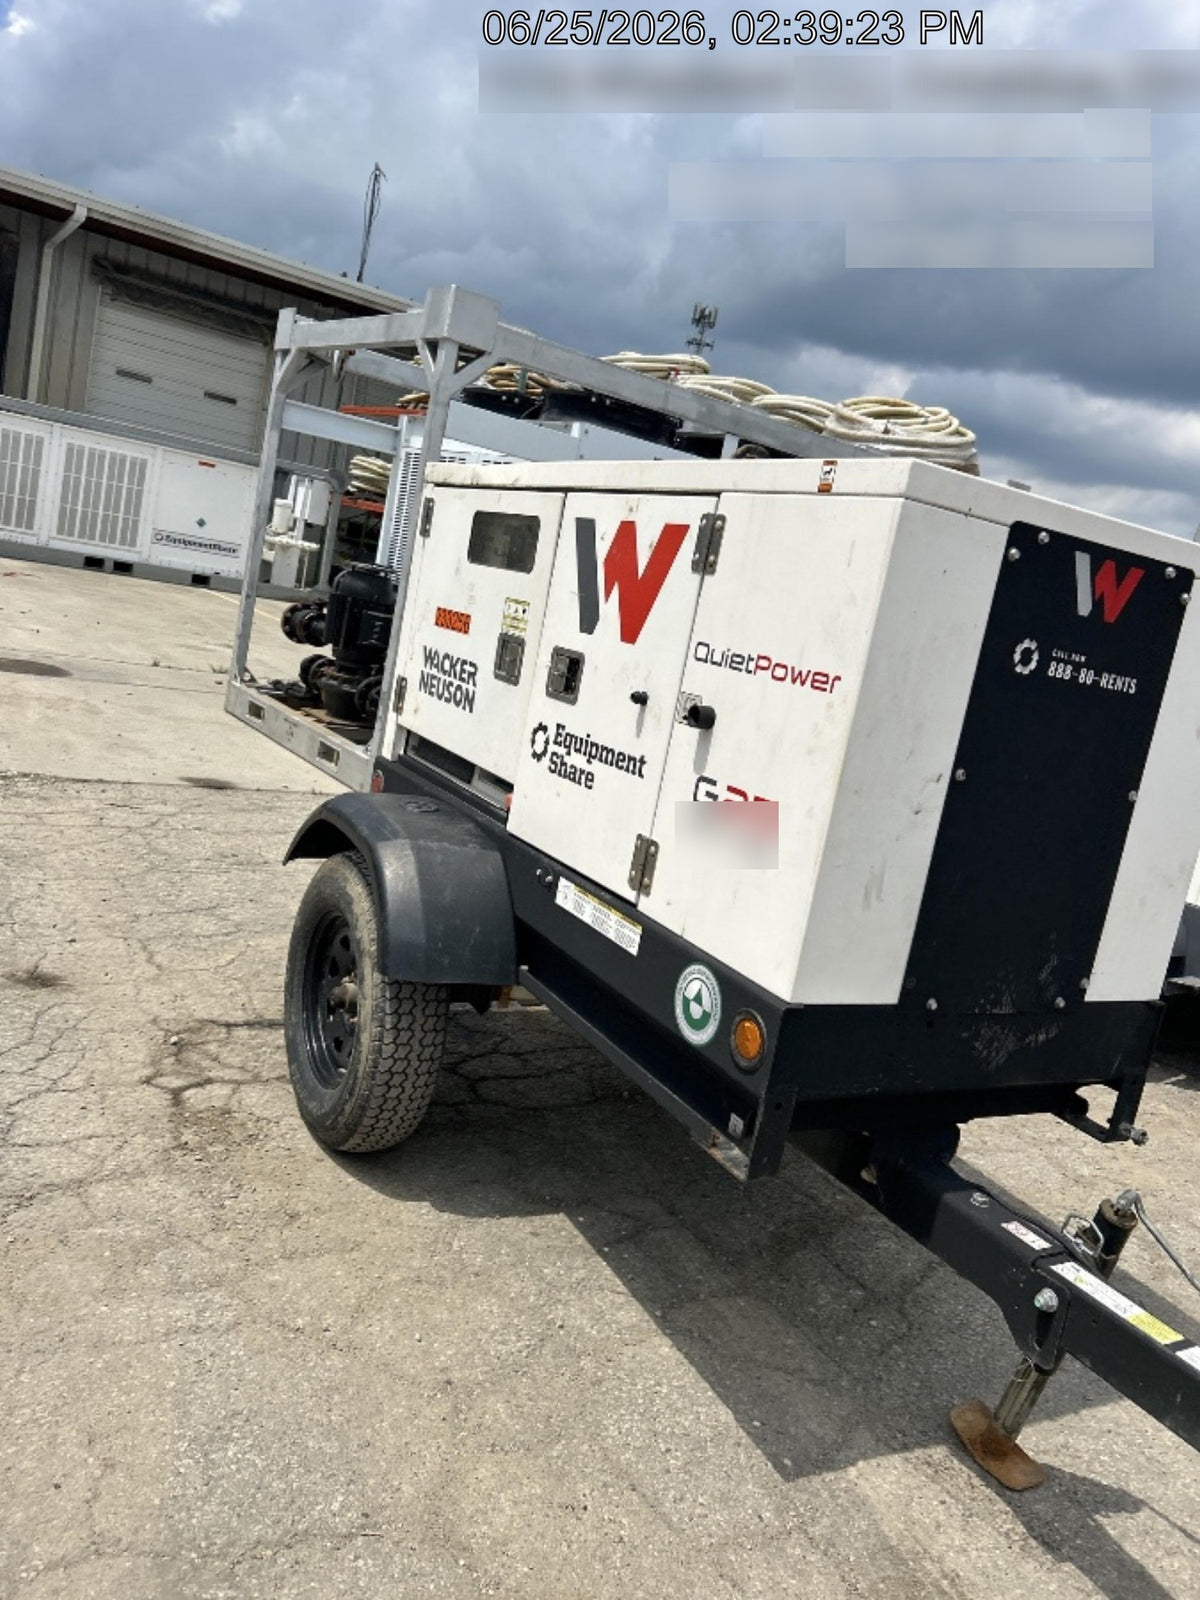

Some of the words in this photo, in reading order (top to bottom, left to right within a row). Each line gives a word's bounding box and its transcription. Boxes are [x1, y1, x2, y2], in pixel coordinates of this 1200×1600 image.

[423, 645, 478, 688] WACKER
[1048, 661, 1137, 694] 888-80-RENTS
[419, 670, 475, 713] NEUSON
[548, 752, 594, 789] Share
[553, 723, 646, 779] Equipment
